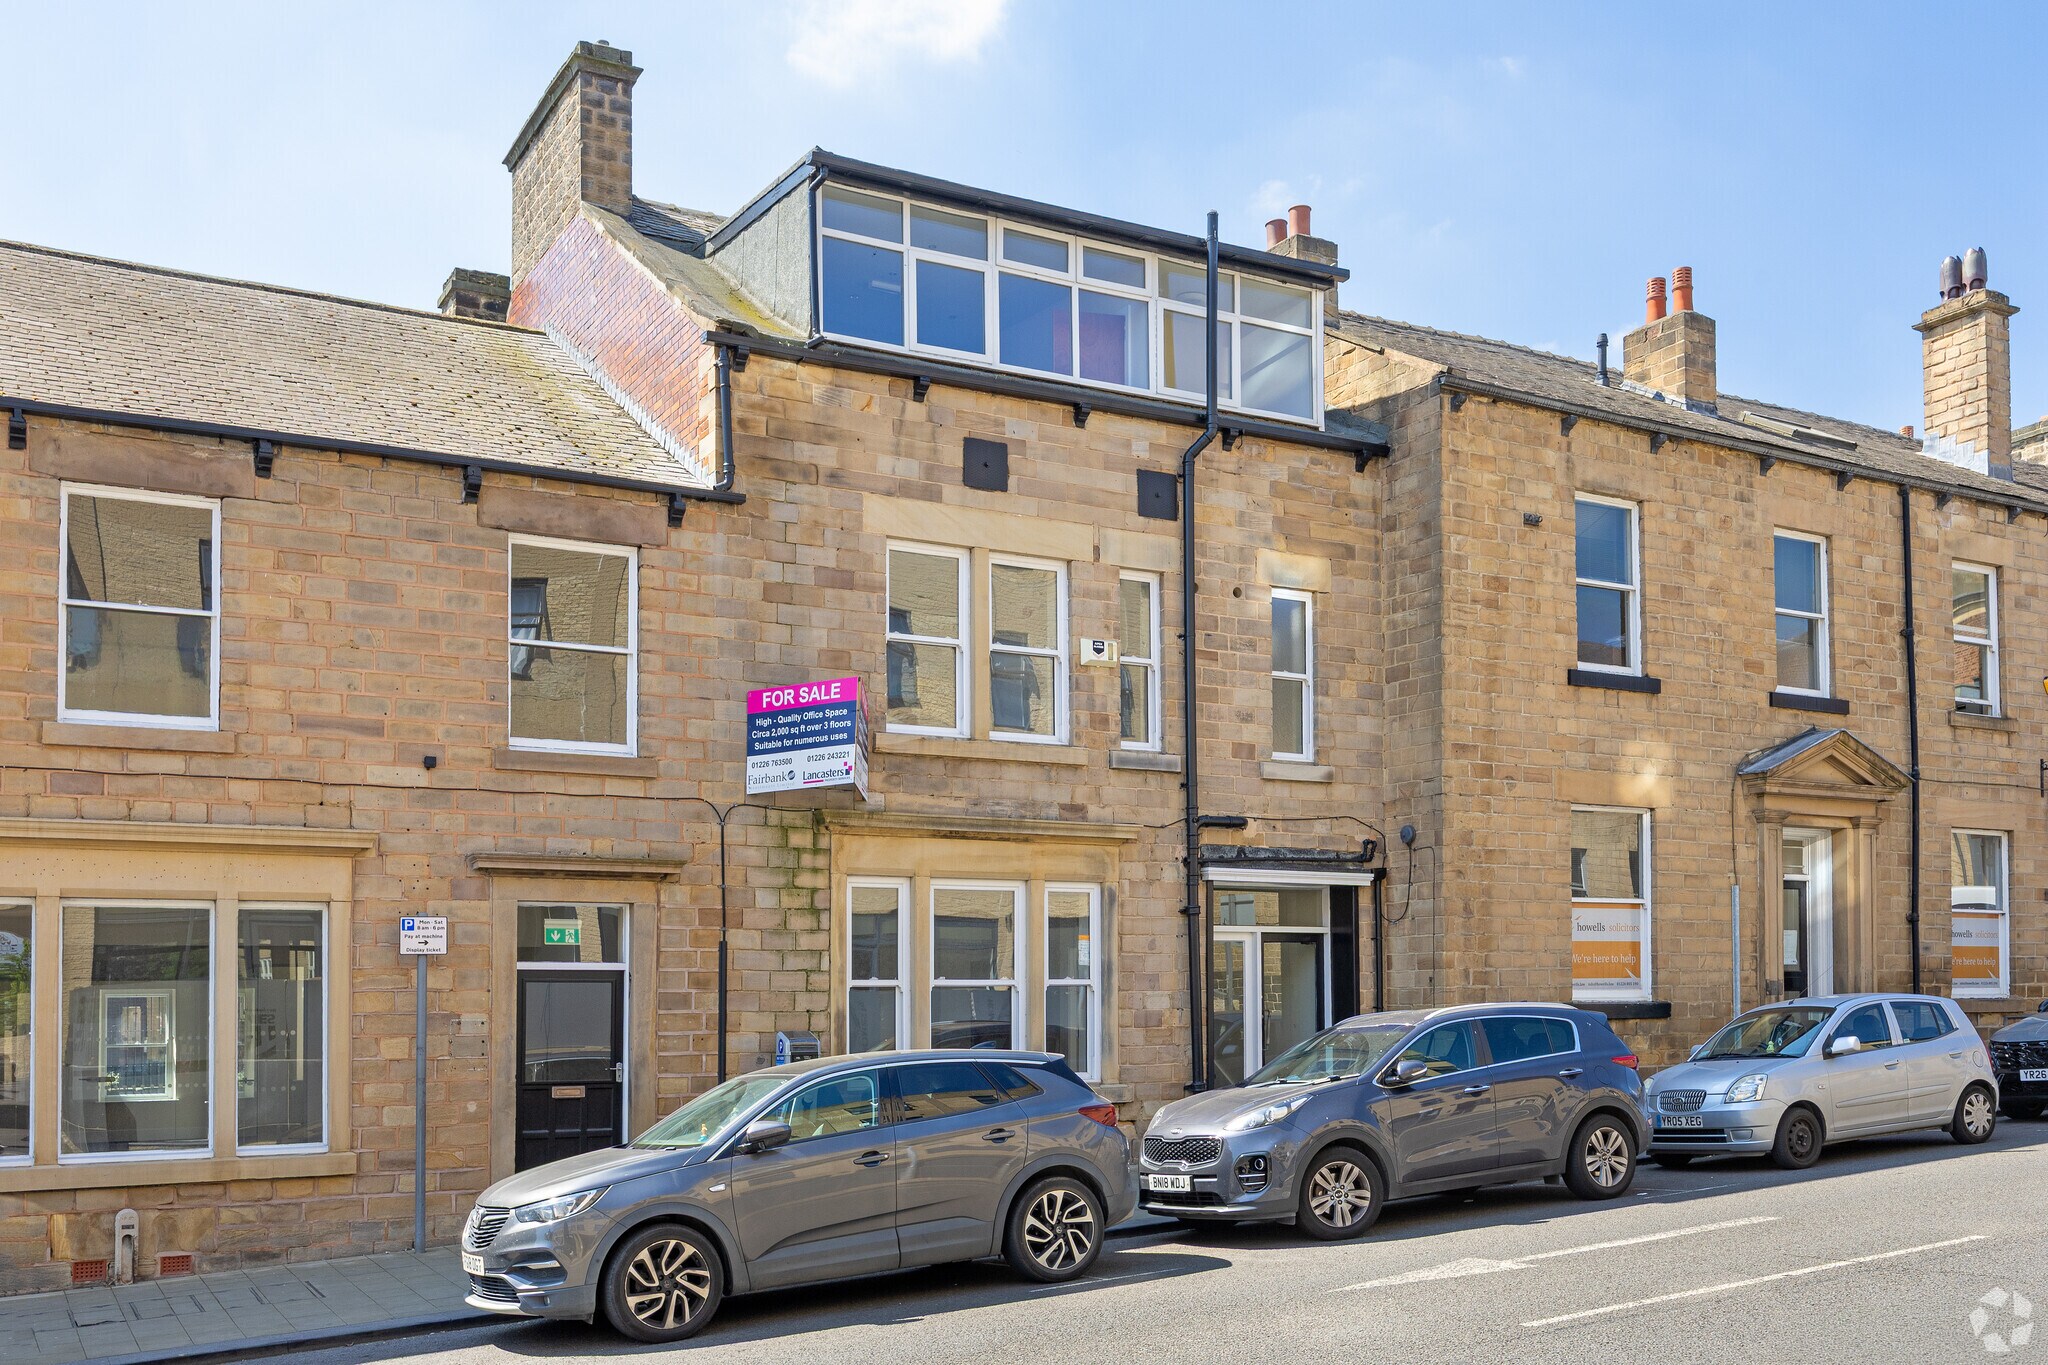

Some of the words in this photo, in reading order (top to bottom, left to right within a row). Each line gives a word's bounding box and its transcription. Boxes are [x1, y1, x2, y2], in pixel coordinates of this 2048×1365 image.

[762, 689, 795, 709] FOR
[798, 682, 841, 703] SALE
[755, 717, 772, 727] High
[777, 712, 802, 724] Quality
[802, 710, 824, 720] Office
[825, 708, 848, 719] Space
[751, 729, 770, 739] Circa
[771, 726, 790, 737] 2,000
[790, 726, 799, 735] sq
[800, 724, 806, 732] ft
[806, 723, 823, 732] over
[829, 720, 852, 729] floors
[754, 738, 782, 751] Suitable
[794, 734, 829, 745] numerous
[830, 732, 848, 741] uses
[806, 753, 826, 762] 01226
[826, 751, 850, 760] 243221
[751, 760, 770, 769] 01226
[771, 757, 793, 767] 763500
[747, 771, 788, 786] Fairbank
[802, 767, 845, 781] Lancasters
[404, 920, 413, 930] P
[1576, 922, 1606, 932] howells
[1608, 922, 1640, 932] solicitors
[1592, 953, 1610, 963] here
[1611, 954, 1619, 963] to
[1620, 954, 1636, 966] help
[1984, 957, 1996, 967] help
[2023, 1070, 2047, 1079] YR26
[1662, 1116, 1683, 1126] YR05
[1685, 1116, 1702, 1126] XEG
